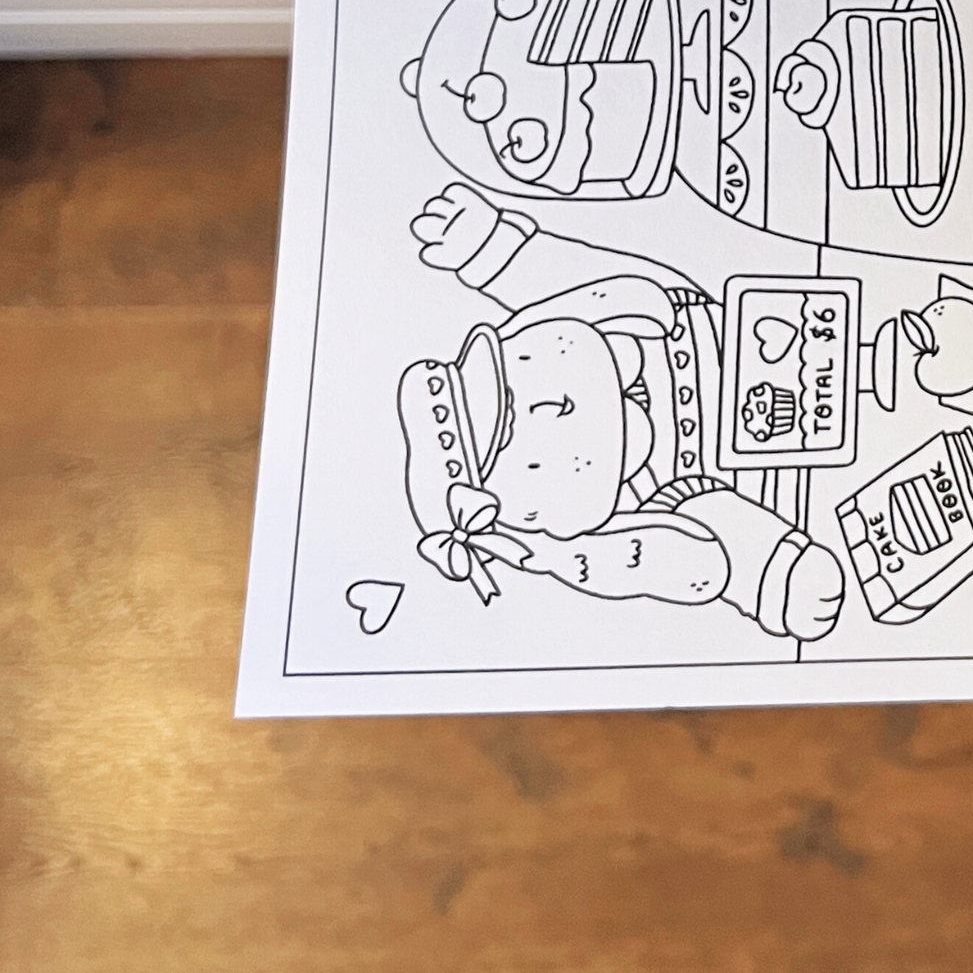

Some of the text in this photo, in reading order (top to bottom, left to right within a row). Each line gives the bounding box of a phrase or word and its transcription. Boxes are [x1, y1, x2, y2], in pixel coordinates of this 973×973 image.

[811, 307, 837, 435] TOTAL $6
[929, 460, 964, 523] BOOK
[868, 512, 905, 574] CAKE
